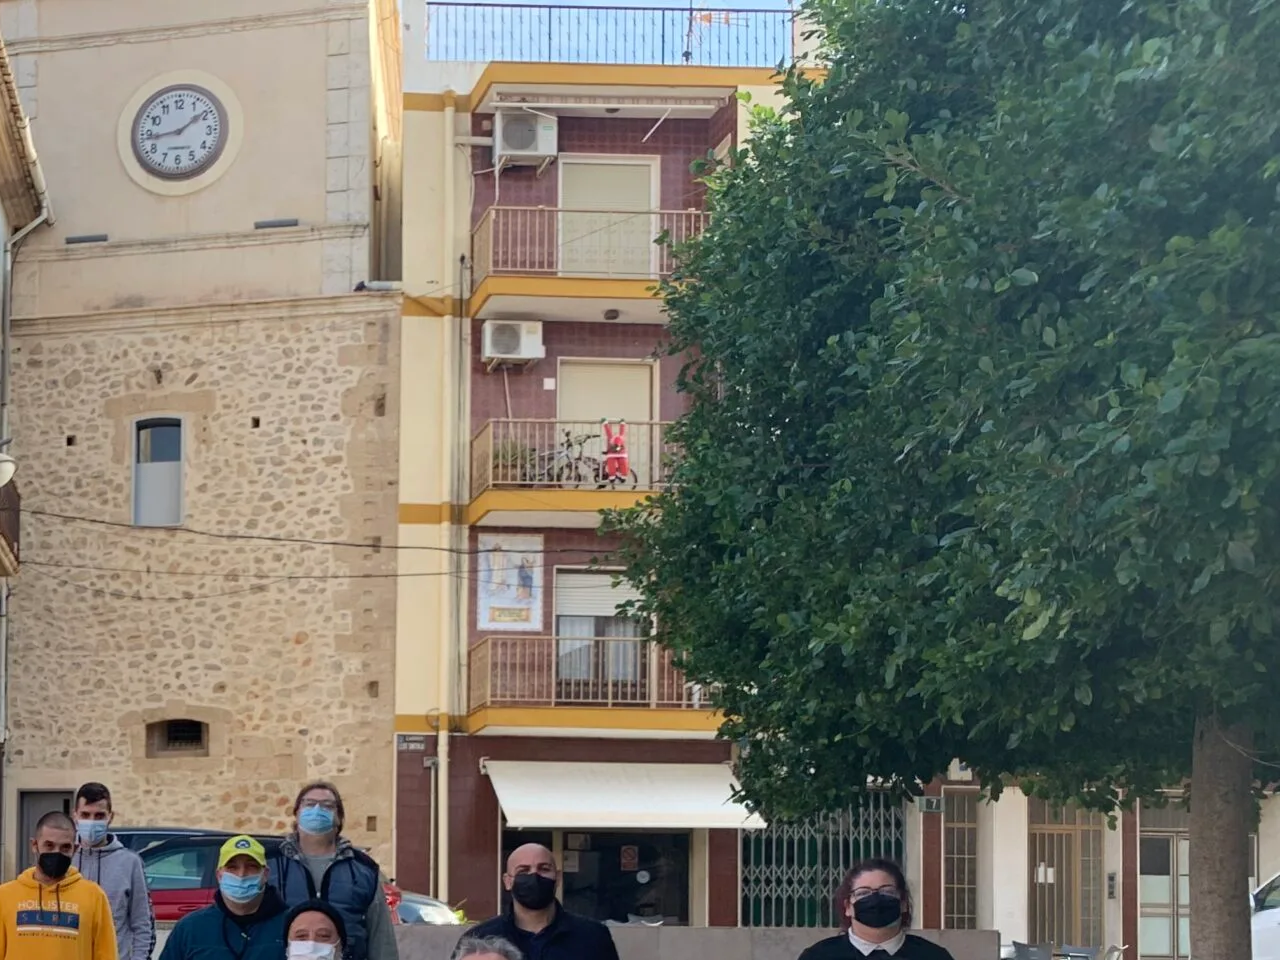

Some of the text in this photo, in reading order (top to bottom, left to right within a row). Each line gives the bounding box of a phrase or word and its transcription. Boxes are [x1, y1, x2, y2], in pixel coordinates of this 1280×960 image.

[161, 104, 170, 115] 11
[174, 99, 185, 110] 12
[191, 102, 196, 111] 1
[151, 115, 161, 126] 10
[202, 110, 209, 121] 2
[146, 129, 153, 140] 9
[206, 125, 212, 136] 3
[150, 144, 158, 154] 8
[200, 140, 206, 150] 4
[162, 152, 168, 163] 7
[174, 155, 182, 165] 6
[188, 151, 195, 161] 5
[931, 799, 937, 809] 7
[17, 899, 79, 911] HOLLISTER
